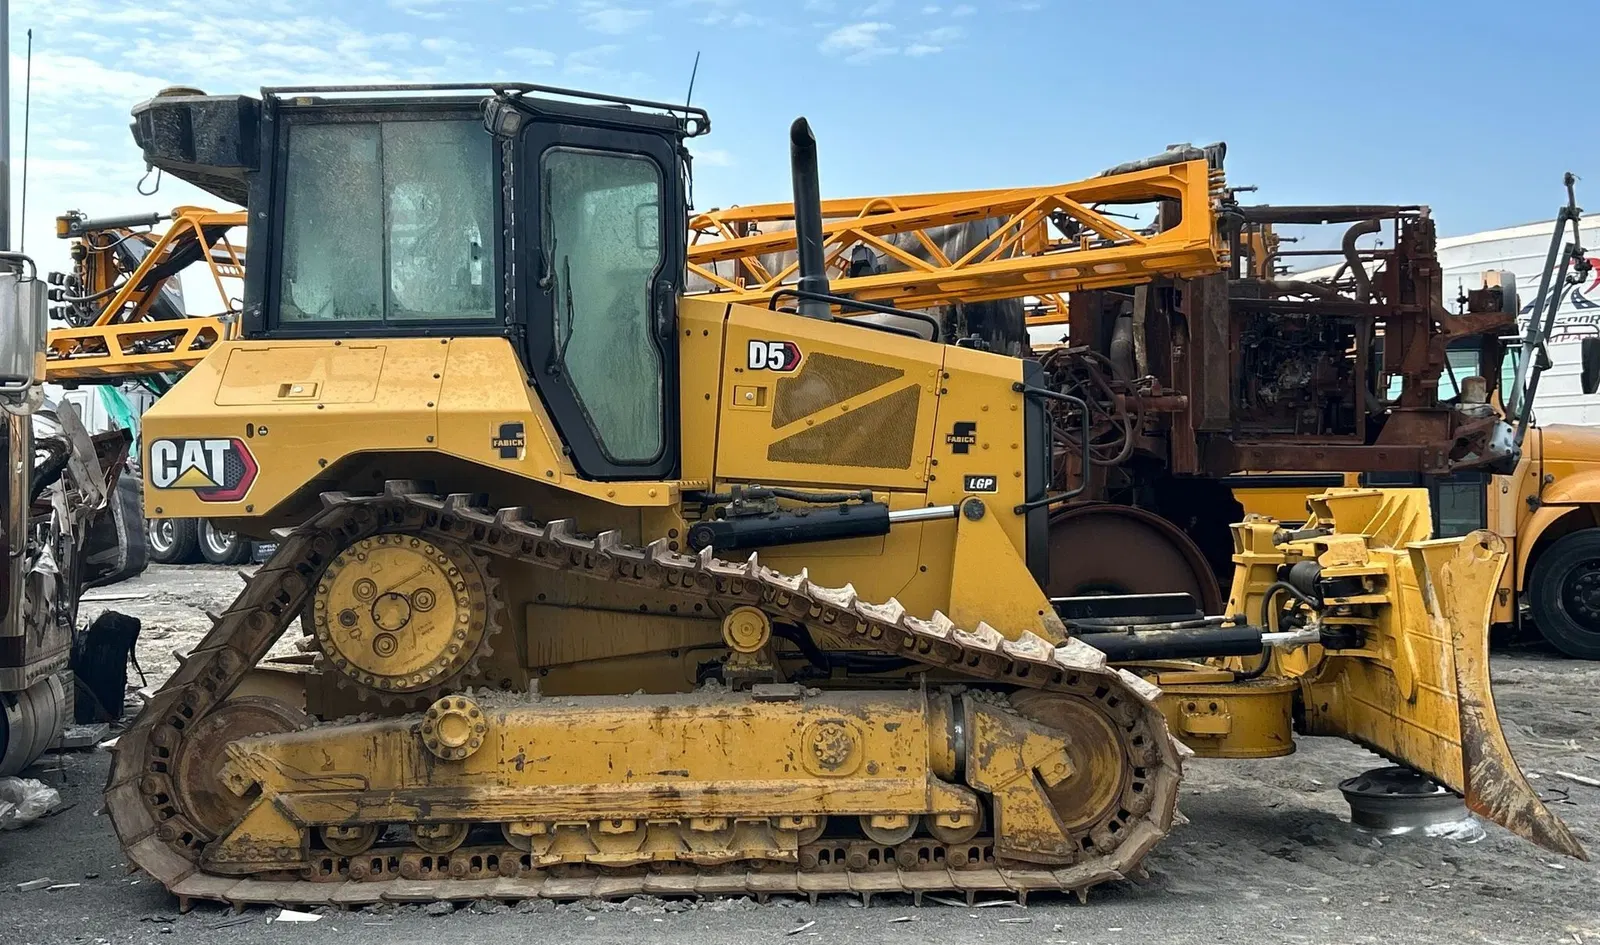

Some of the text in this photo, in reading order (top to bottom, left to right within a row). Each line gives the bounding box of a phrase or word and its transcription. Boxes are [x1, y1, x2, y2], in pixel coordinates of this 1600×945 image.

[749, 341, 785, 369] D5
[493, 439, 523, 447] FABICK
[151, 440, 231, 488] CAT
[969, 478, 993, 489] LGP
